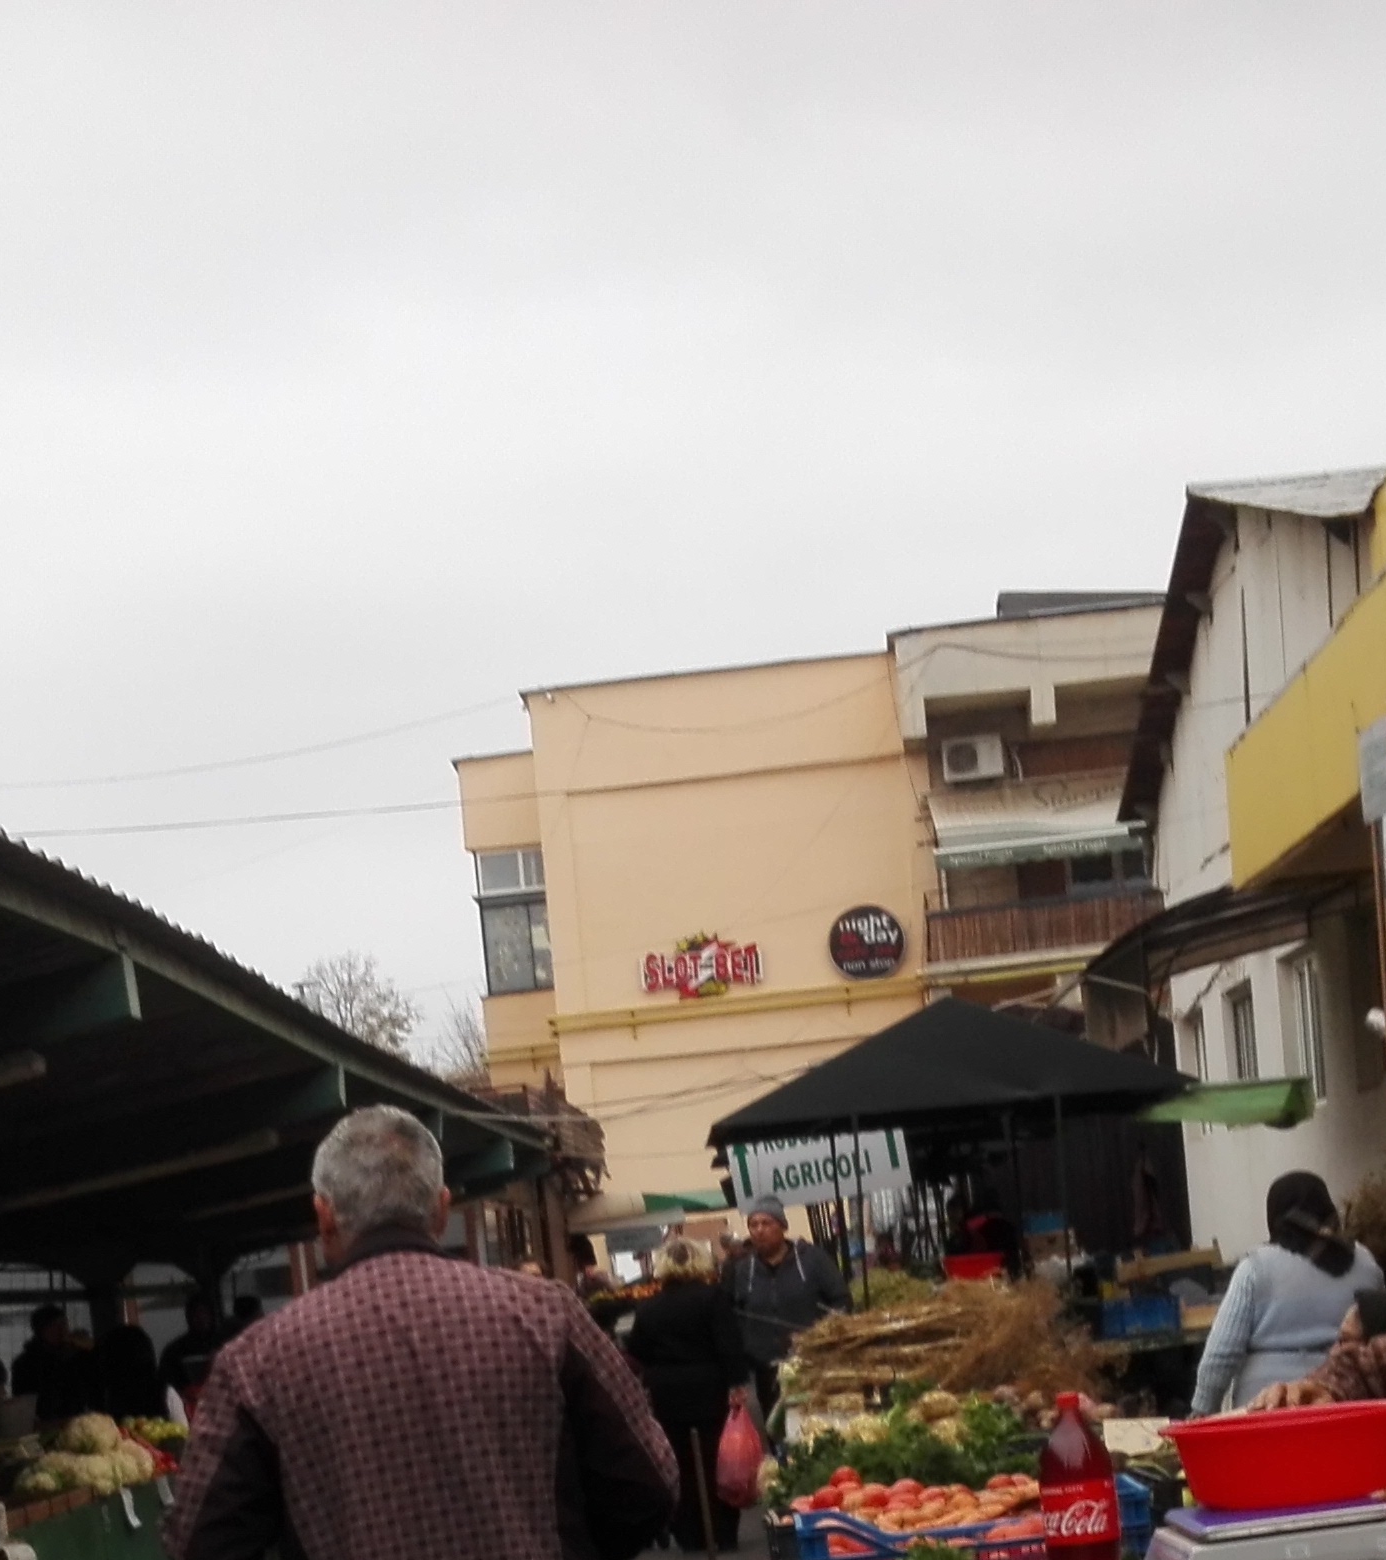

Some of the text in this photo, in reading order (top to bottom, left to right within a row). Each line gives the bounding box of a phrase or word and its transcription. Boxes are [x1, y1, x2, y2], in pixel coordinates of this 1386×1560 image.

[641, 943, 761, 993] SLOT BET
[771, 1148, 873, 1194] AGRICOLI
